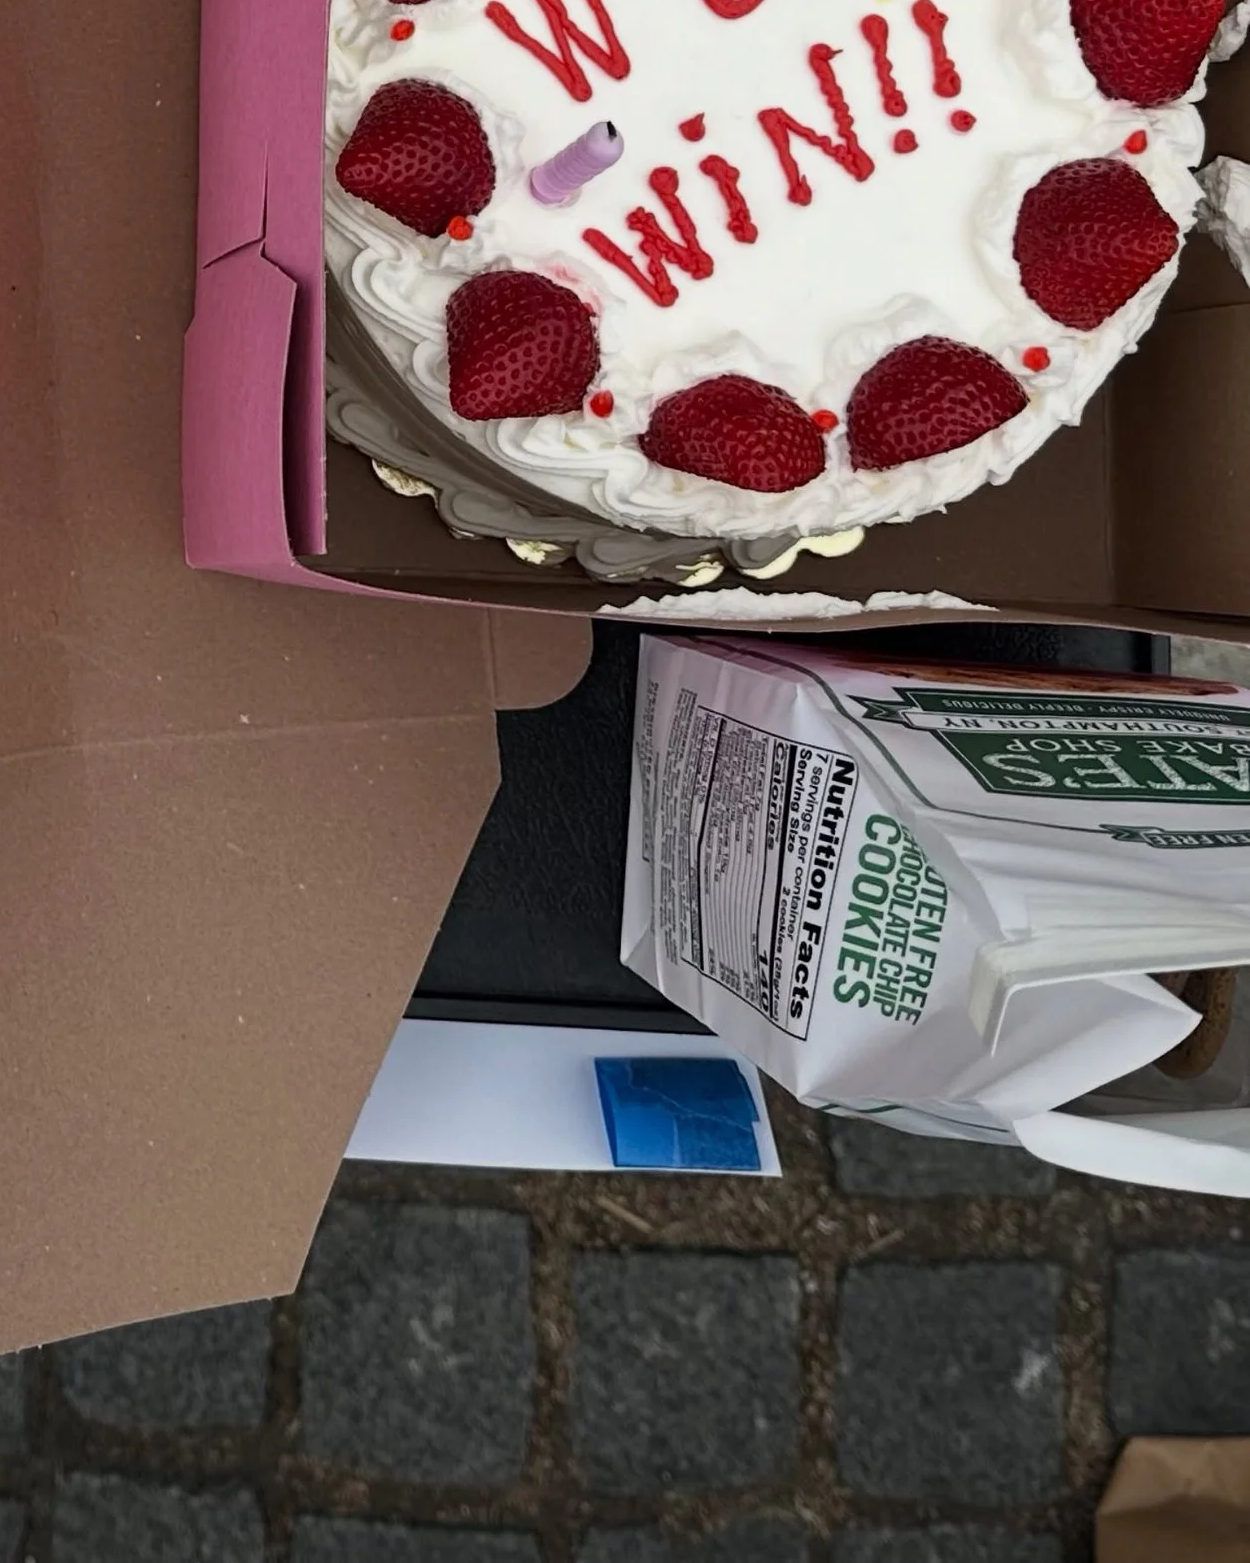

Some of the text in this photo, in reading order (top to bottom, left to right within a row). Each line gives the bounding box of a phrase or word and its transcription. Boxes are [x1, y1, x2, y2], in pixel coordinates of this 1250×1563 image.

[943, 699, 1027, 711] DELICIOUS
[943, 717, 983, 728] NY
[982, 752, 1250, 793] ATE'S
[1005, 738, 1123, 753] SHOP
[790, 748, 812, 815] Serving
[787, 817, 801, 853] Size
[787, 753, 829, 940] 7 servings per container
[758, 742, 784, 1013] Calories 140
[790, 758, 856, 1020] Nutrition Facts
[775, 898, 788, 956] cookies
[833, 813, 901, 1008] COOKIES
[870, 957, 903, 1017] CHIP
[895, 945, 938, 1026] FREE
